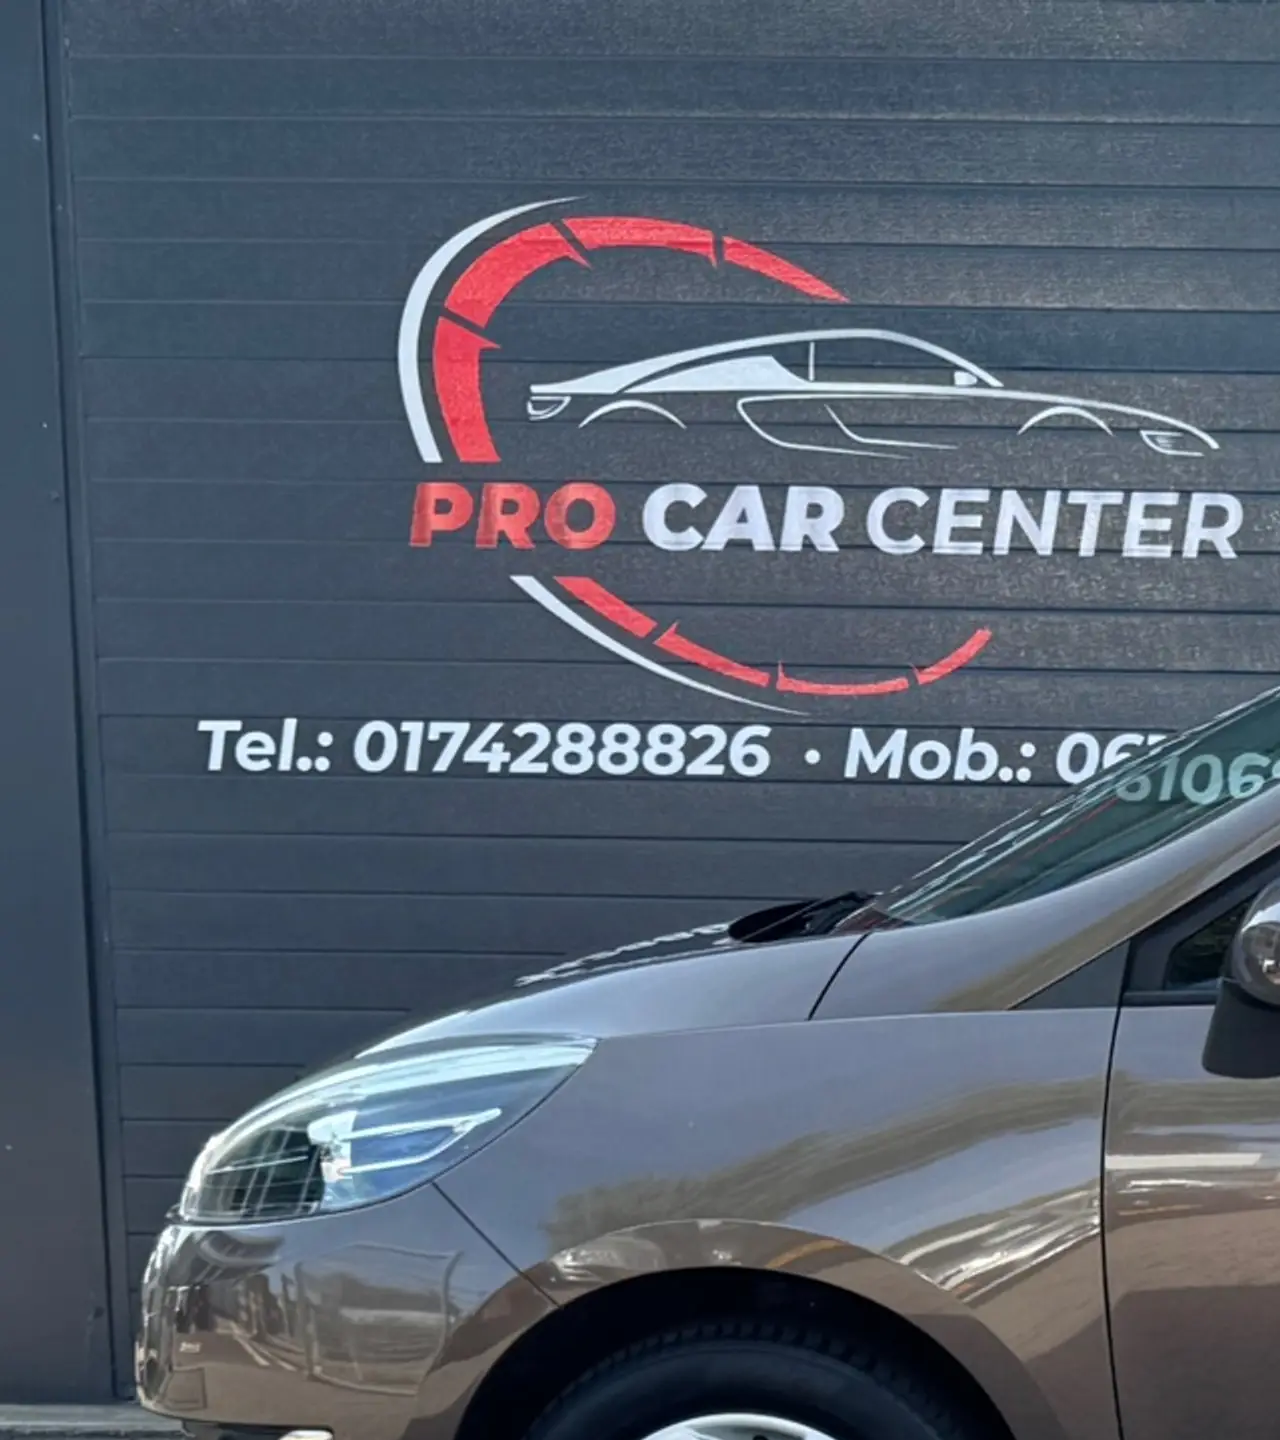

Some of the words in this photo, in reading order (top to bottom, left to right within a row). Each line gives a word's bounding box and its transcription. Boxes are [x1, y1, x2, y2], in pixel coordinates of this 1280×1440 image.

[409, 482, 616, 550] PRO
[642, 483, 845, 552] CAR
[866, 487, 1244, 559] CENTER
[197, 717, 333, 772] Tel.:
[354, 720, 772, 777] 0174288826
[844, 727, 1034, 783] Mob.:
